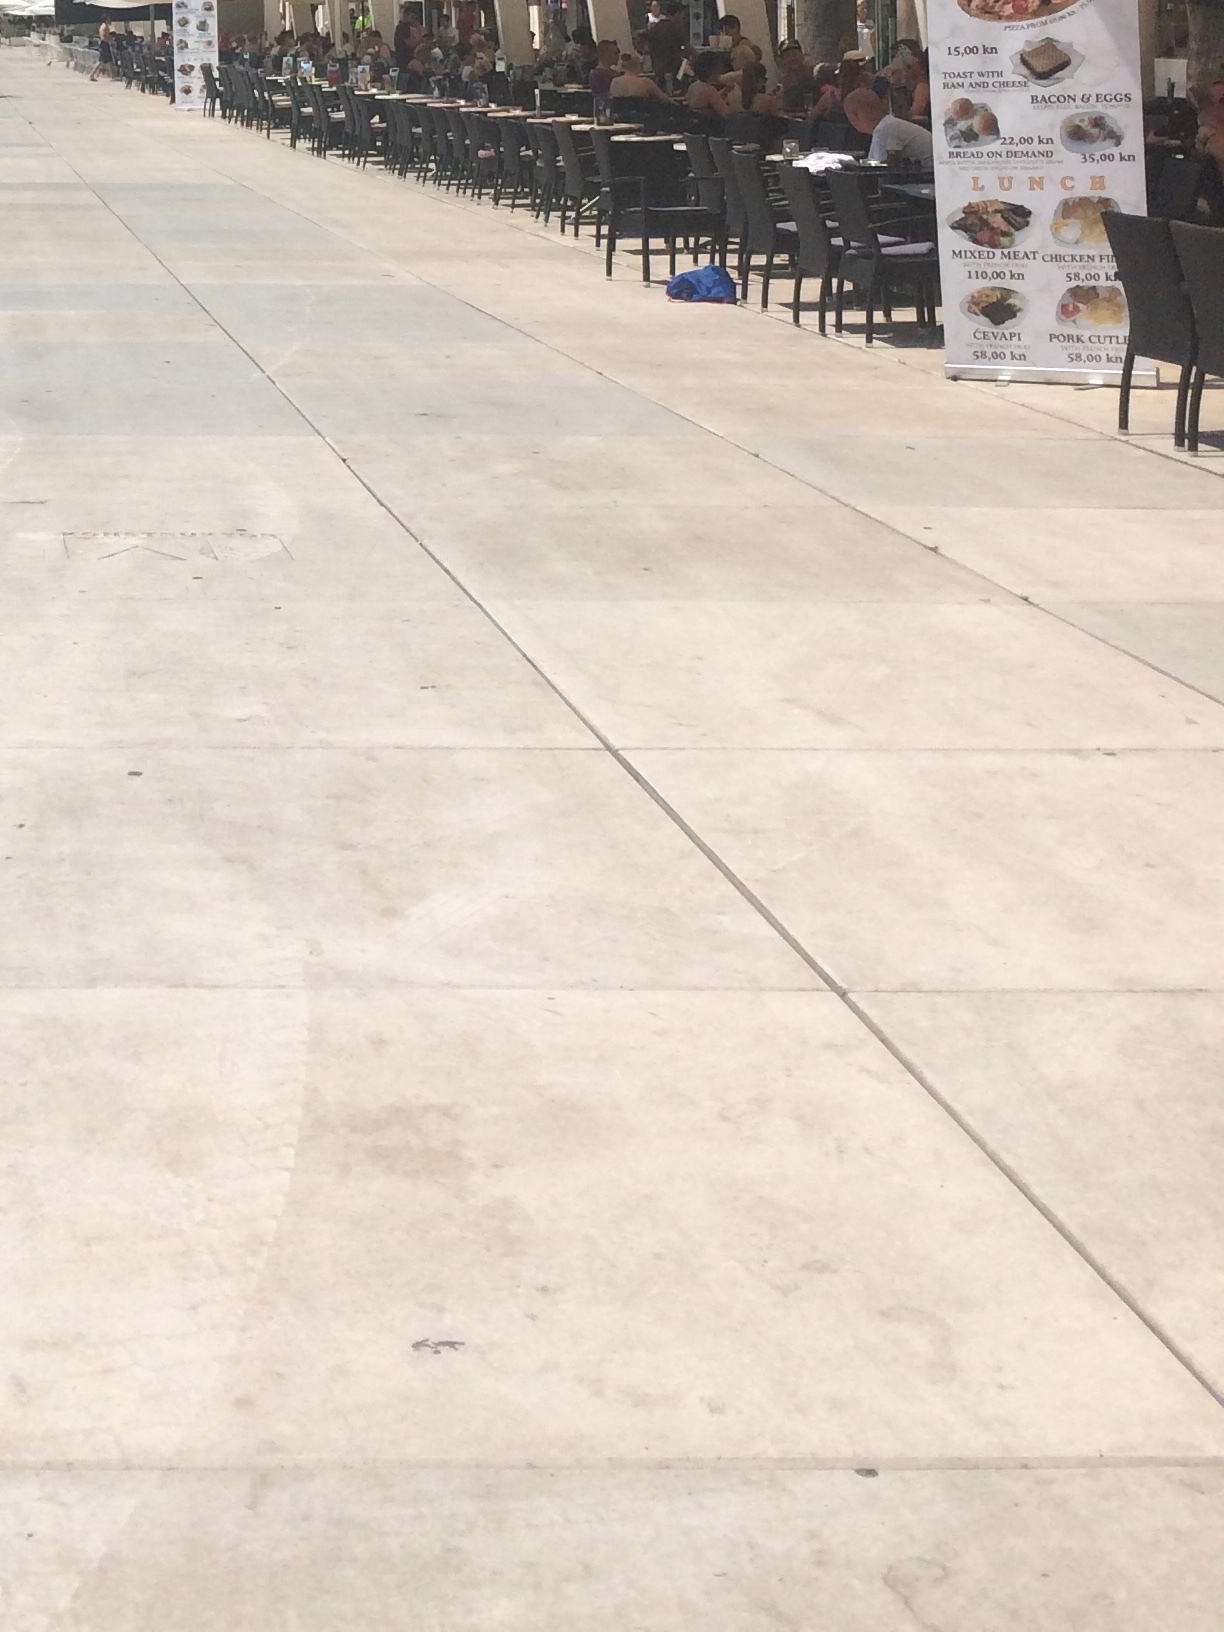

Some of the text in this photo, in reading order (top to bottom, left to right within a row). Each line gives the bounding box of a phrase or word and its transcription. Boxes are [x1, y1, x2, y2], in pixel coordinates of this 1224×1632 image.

[947, 44, 998, 57] 15,00 kn
[942, 70, 1004, 79] TOAST WITH
[942, 80, 1030, 90] HAM AND CHEESE
[1030, 92, 1133, 105] BACON & EGGS
[999, 135, 1054, 146] 22,00 kn
[948, 150, 1054, 159] BREAD ON DEMAND
[1080, 152, 1136, 164] 35,00 kn
[971, 175, 1106, 192] LUNCH
[951, 250, 1039, 260] MIXED MEAT
[1041, 254, 1095, 263] CHICKEN
[967, 270, 1025, 280] 110,00 kn
[1065, 272, 1101, 282] 58,00
[1049, 333, 1085, 344] PORK
[972, 350, 1027, 361] 58,00 kn
[1068, 353, 1123, 364] 58,00 kn
